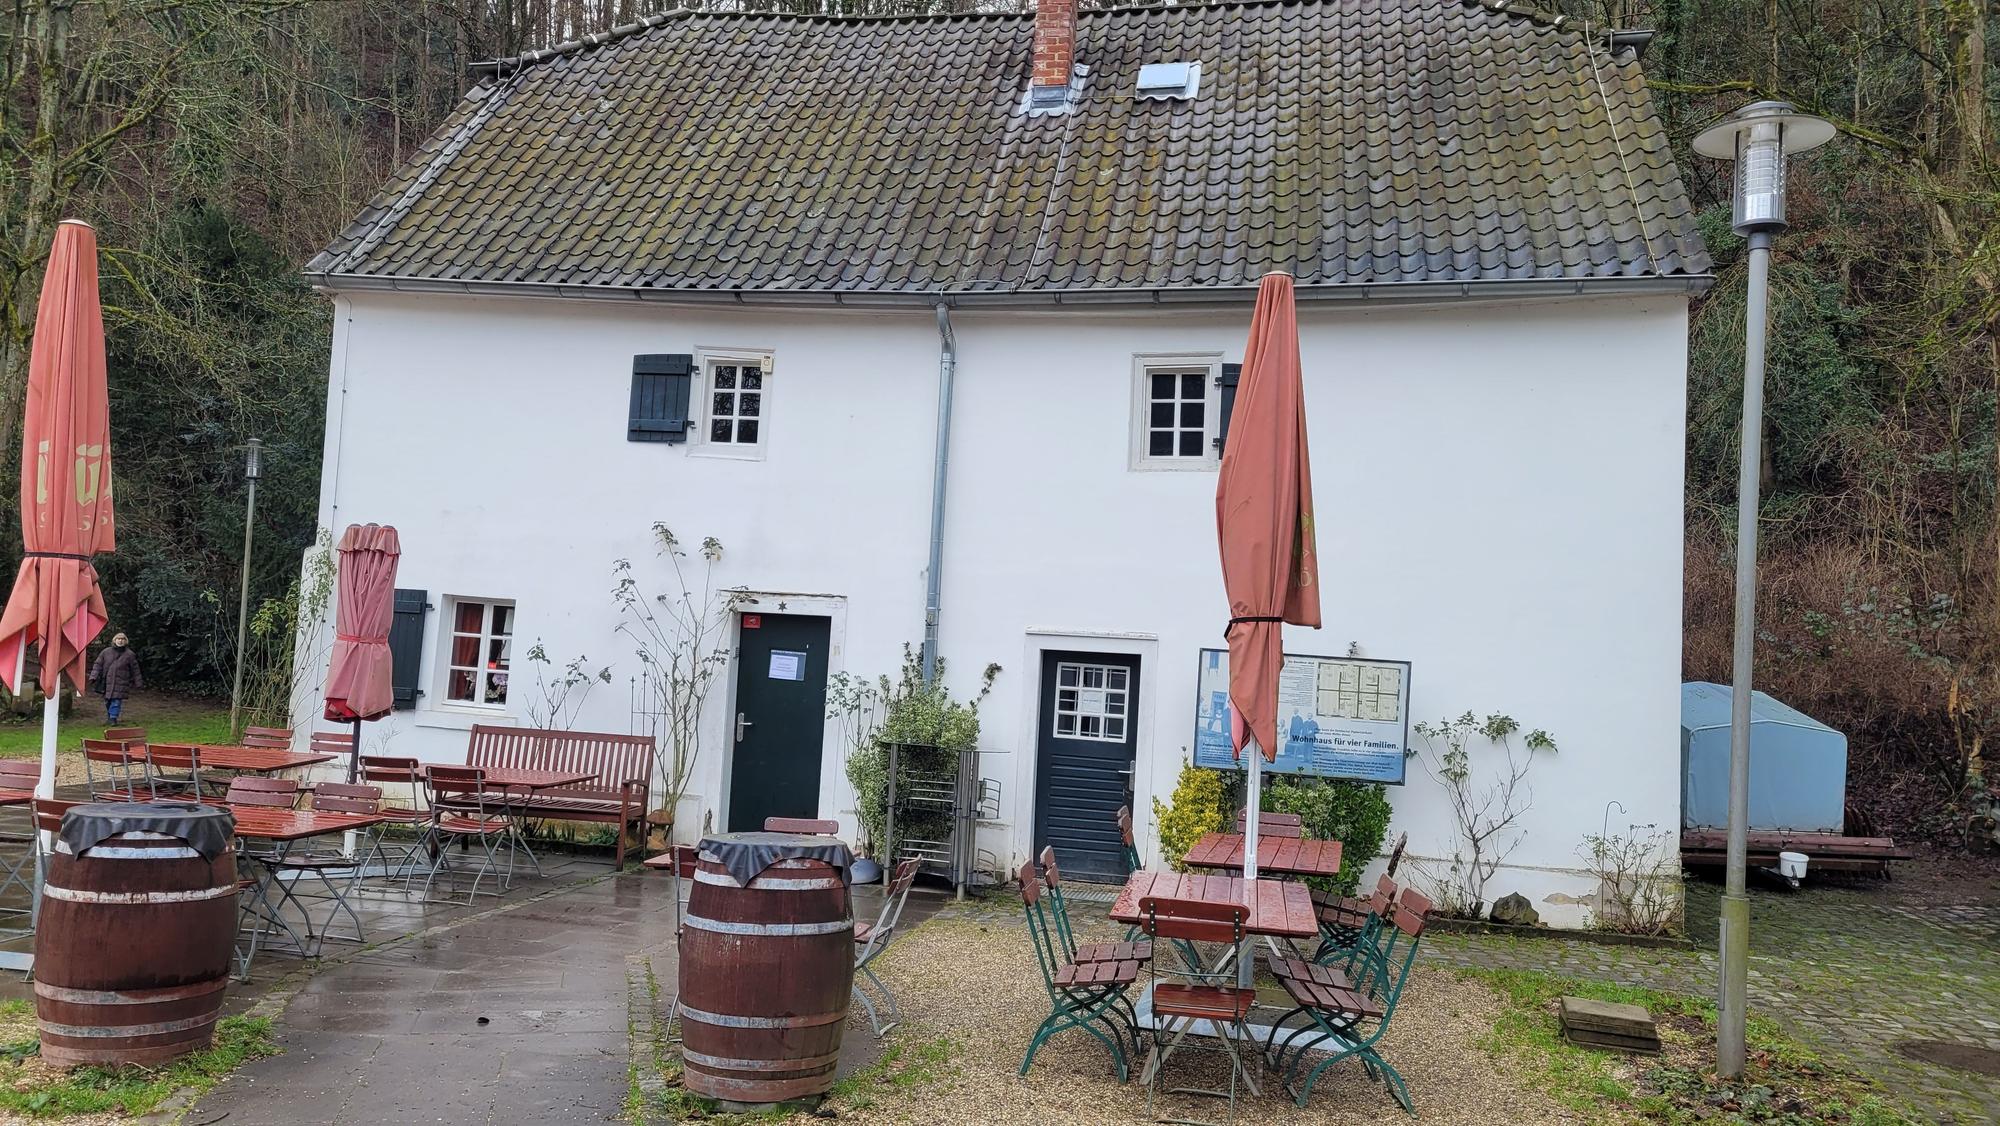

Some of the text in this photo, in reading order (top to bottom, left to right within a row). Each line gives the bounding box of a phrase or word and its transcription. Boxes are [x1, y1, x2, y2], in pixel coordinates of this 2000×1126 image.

[1292, 735, 1399, 750] Wohnhaus für vier Familien.
